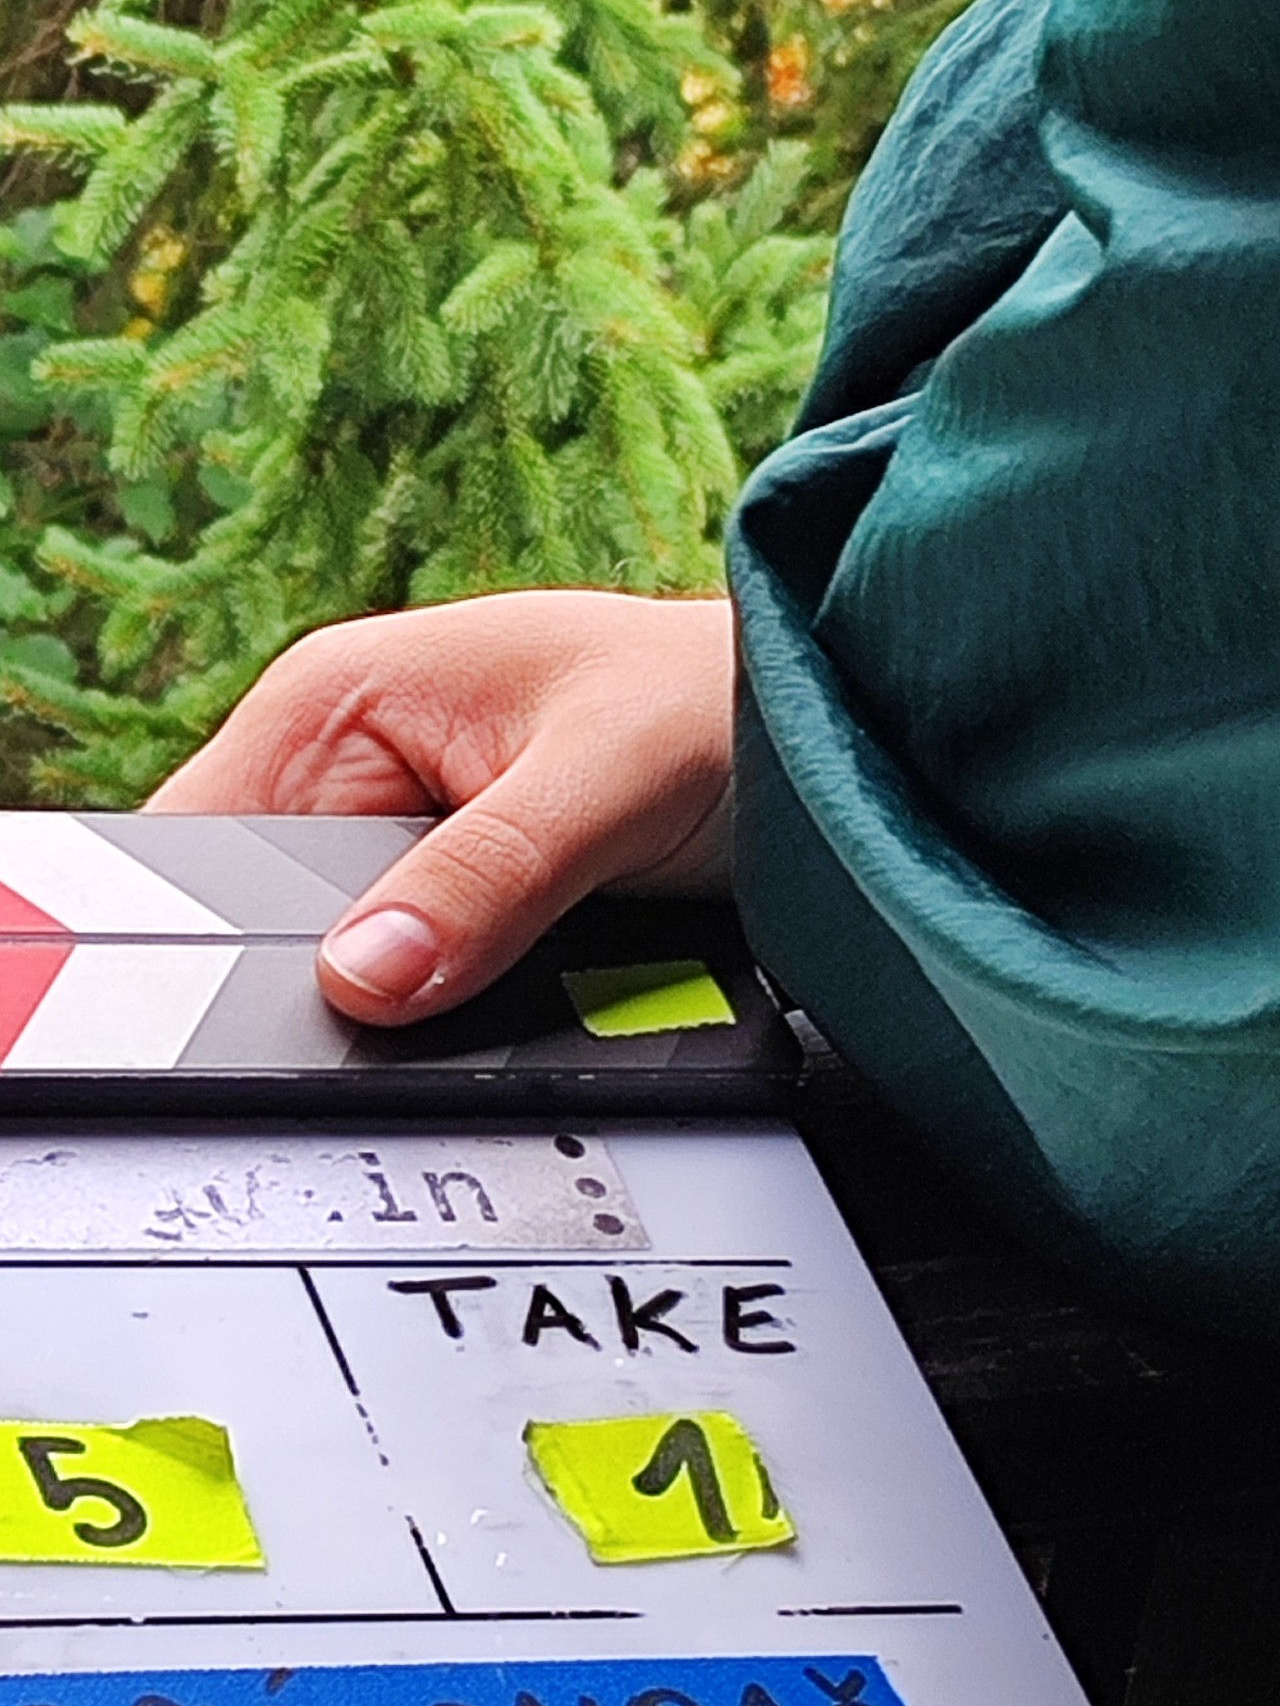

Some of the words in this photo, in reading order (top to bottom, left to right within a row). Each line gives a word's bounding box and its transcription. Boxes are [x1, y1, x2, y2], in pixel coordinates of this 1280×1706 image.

[388, 1276, 796, 1358] TAKE
[18, 1435, 148, 1548] 5
[631, 1418, 738, 1543] 1
